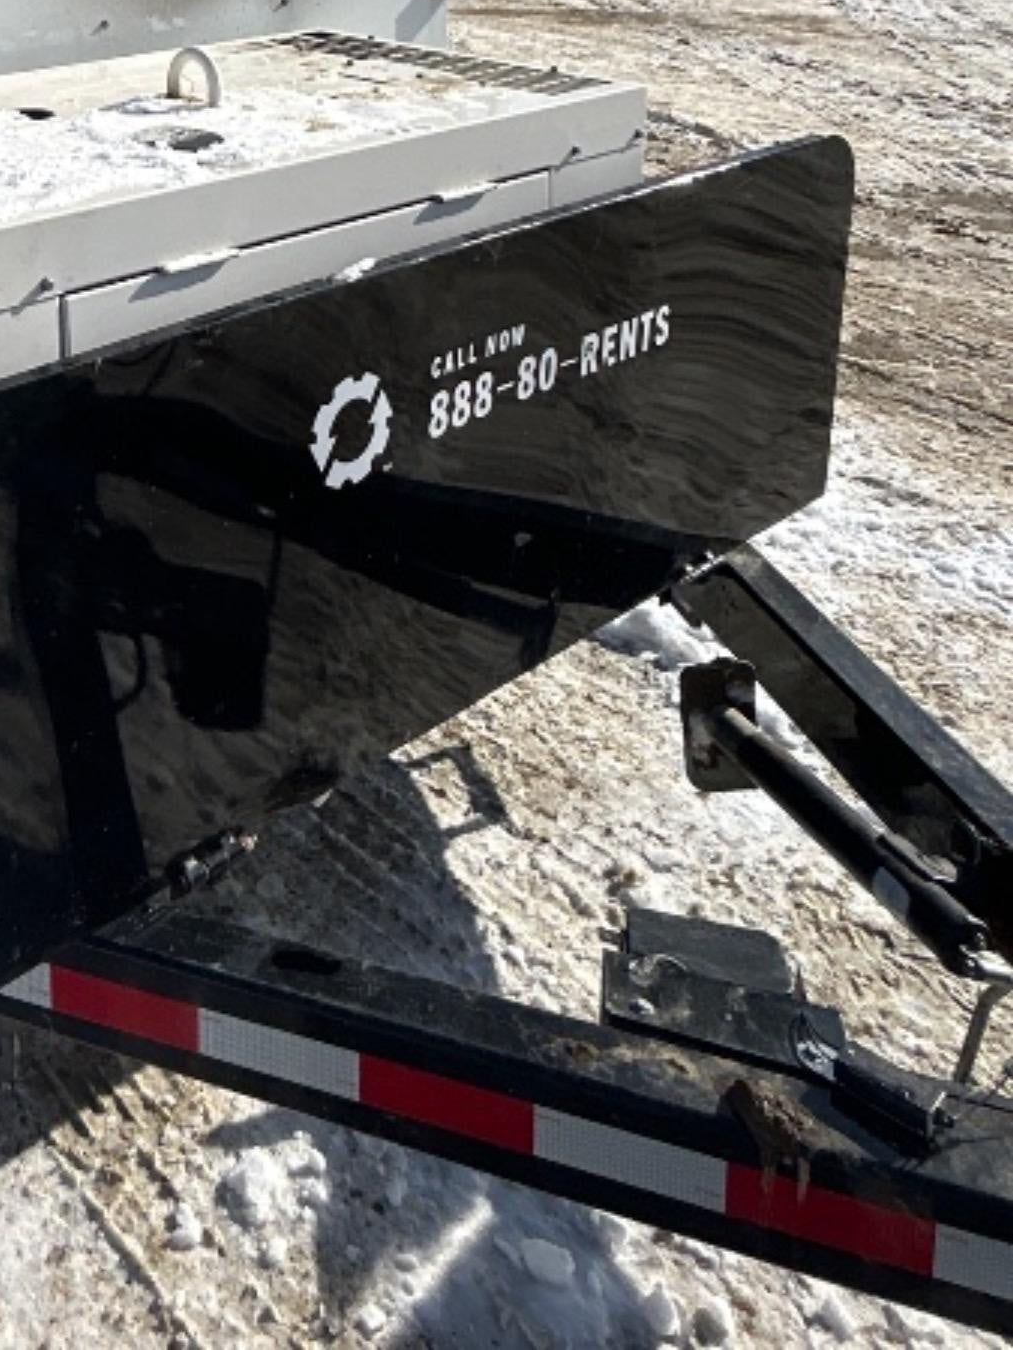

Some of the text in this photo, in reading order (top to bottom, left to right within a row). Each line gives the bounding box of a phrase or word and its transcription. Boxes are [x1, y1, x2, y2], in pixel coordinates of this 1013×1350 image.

[428, 304, 670, 439] 888-80-RENTS
[430, 323, 526, 379] CALL NOW
